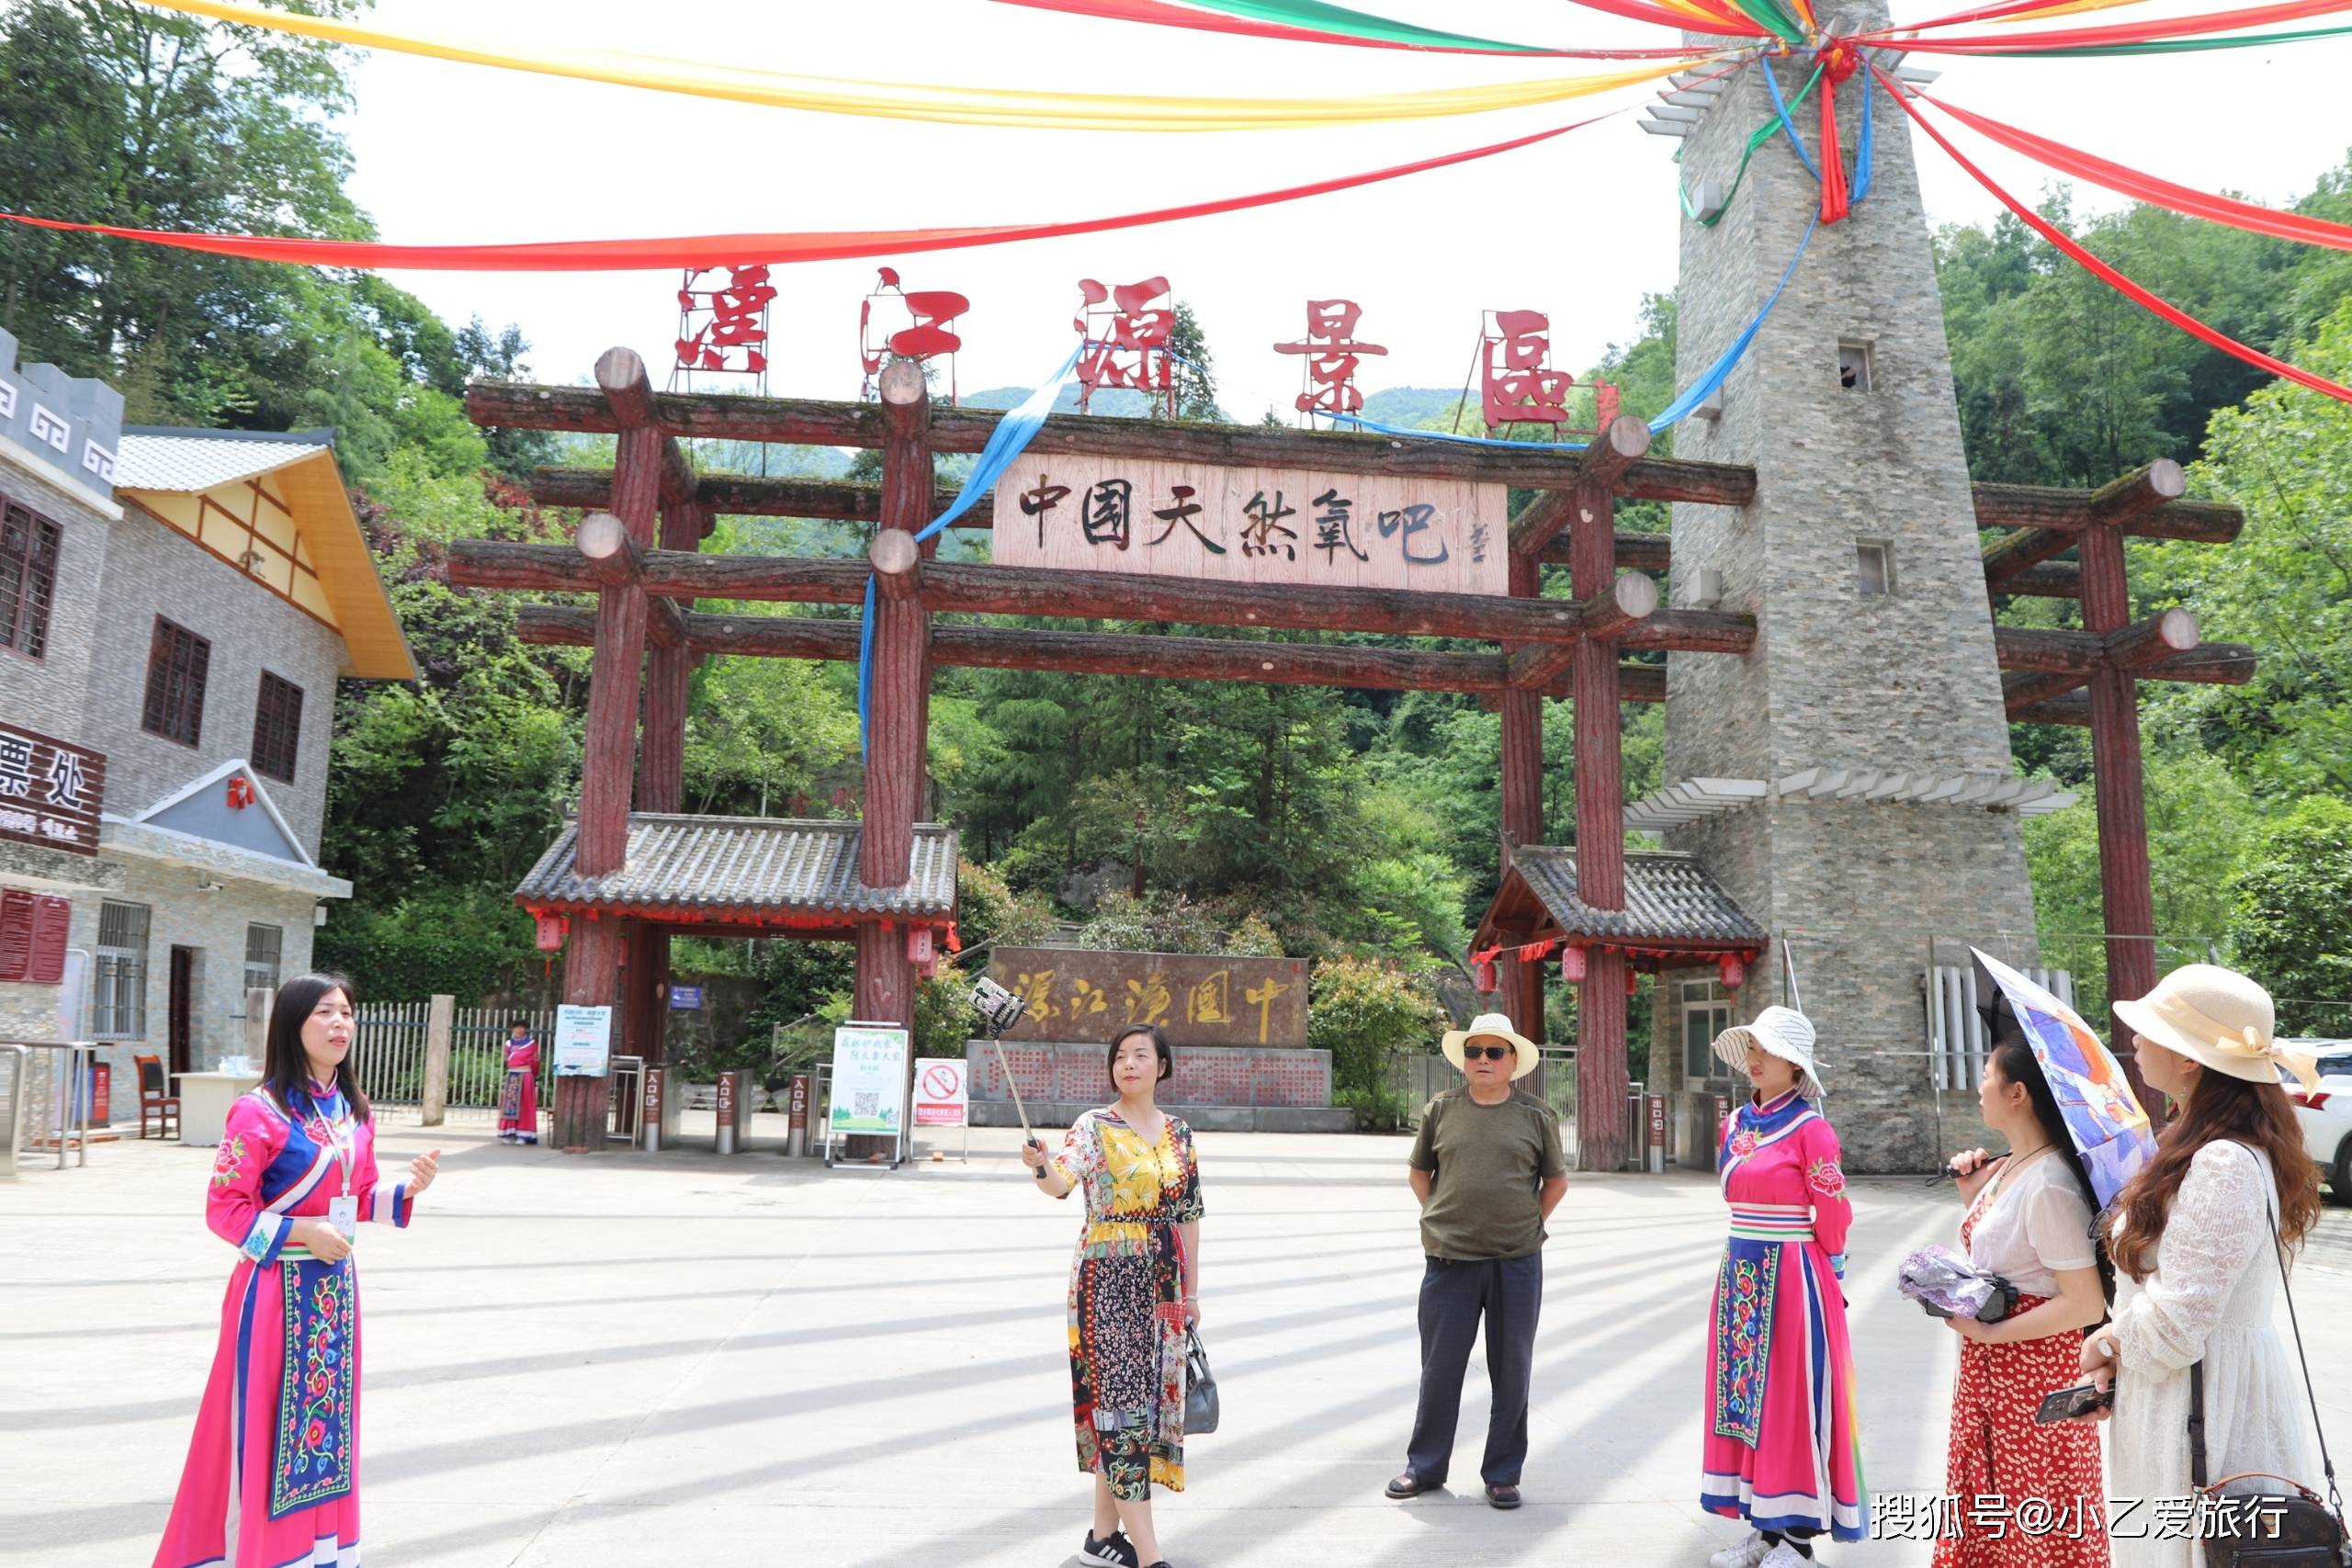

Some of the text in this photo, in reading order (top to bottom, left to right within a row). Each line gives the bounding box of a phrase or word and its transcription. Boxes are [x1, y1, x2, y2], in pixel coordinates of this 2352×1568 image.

[647, 1074, 657, 1094] 入口
[719, 1077, 730, 1096] 入口
[794, 1079, 804, 1099] 入口
[1653, 1100, 1662, 1118] 出口
